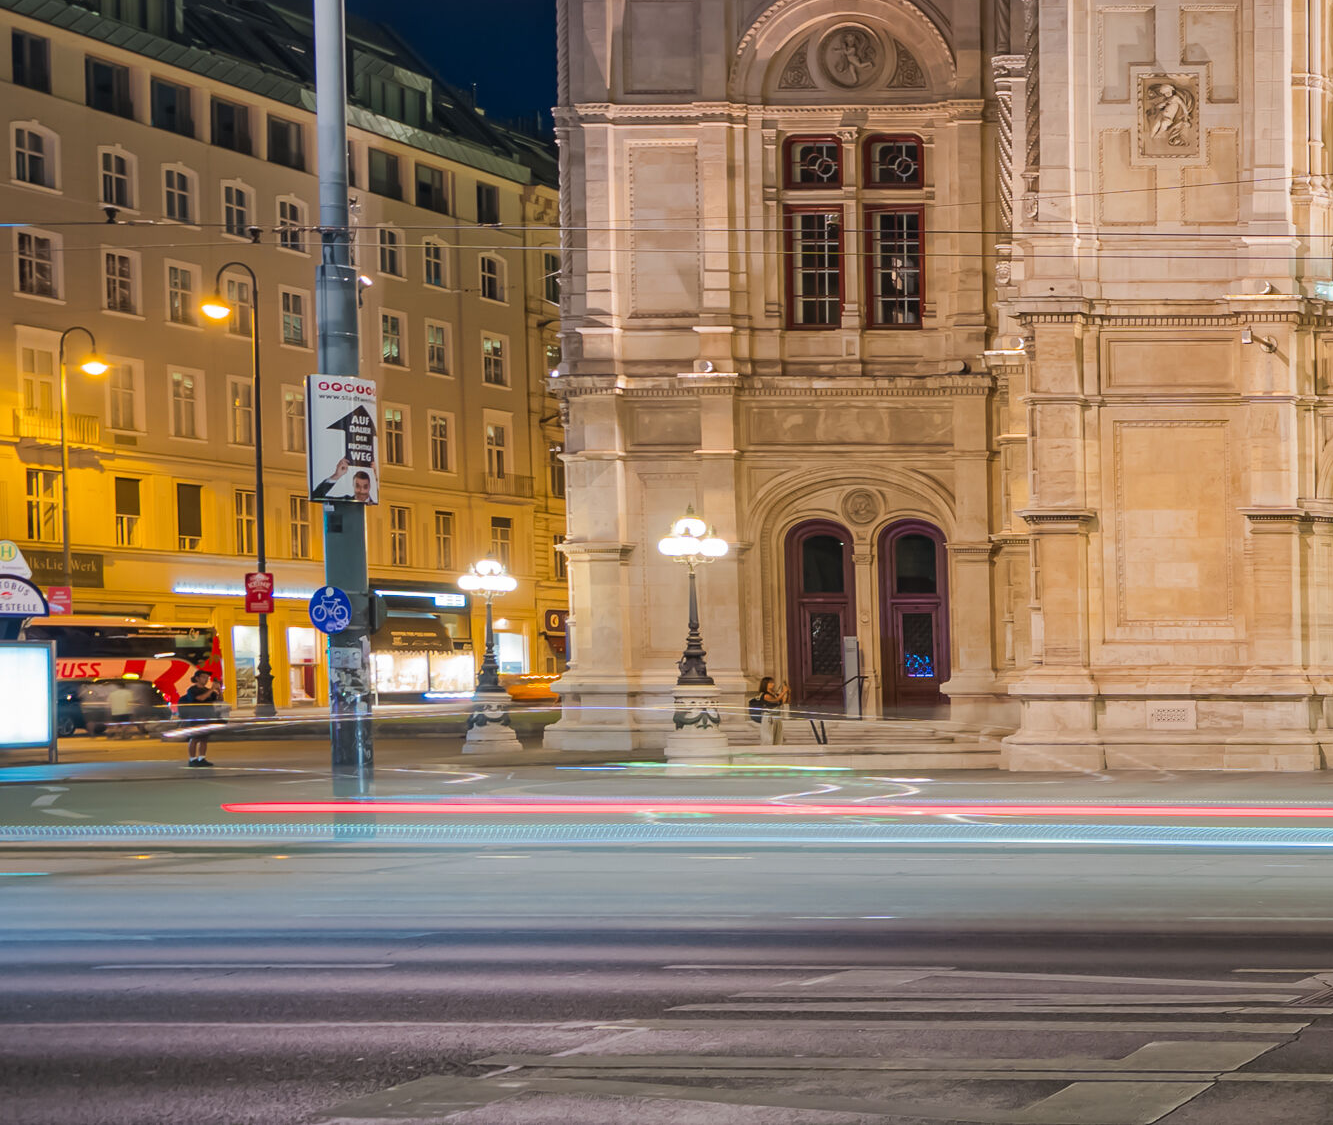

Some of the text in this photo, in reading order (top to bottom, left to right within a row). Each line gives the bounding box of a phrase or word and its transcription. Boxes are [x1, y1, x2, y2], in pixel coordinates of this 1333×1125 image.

[351, 415, 370, 426] AUF
[350, 451, 372, 463] WEG
[1, 546, 12, 557] H
